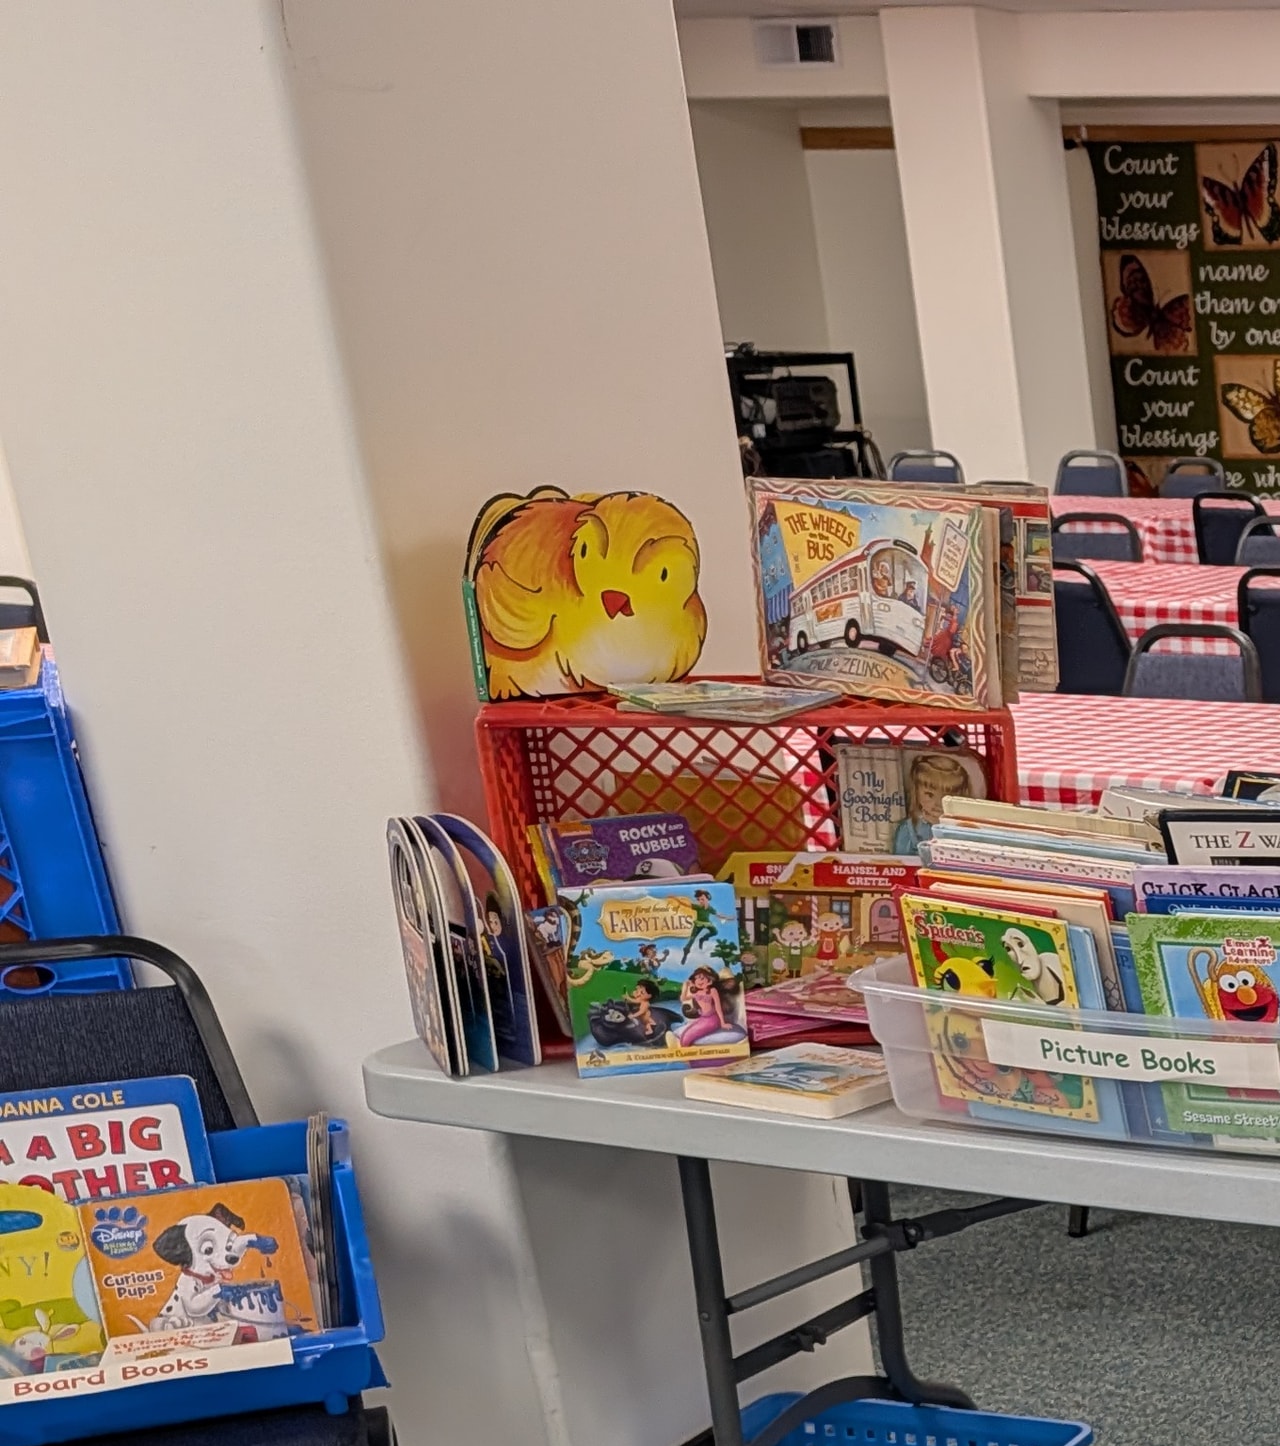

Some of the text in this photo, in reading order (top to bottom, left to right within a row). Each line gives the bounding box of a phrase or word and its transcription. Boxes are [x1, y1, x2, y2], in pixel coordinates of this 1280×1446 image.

[1104, 145, 1179, 175] Count
[1116, 187, 1173, 214] your
[1100, 217, 1199, 249] blessings
[1200, 263, 1269, 281] name
[1195, 293, 1254, 314] them
[1210, 323, 1235, 350] by
[1124, 358, 1199, 387] Count
[1140, 400, 1194, 426] your
[1121, 426, 1218, 455] blessings
[784, 512, 855, 547] THE WHEELS
[807, 540, 834, 562] BUS
[852, 770, 884, 792] My
[843, 788, 905, 808] Goodnight
[853, 806, 892, 823] Book
[619, 823, 667, 842] ROCKY
[1190, 834, 1232, 849] THE
[1235, 830, 1255, 849] Z
[630, 835, 687, 856] RUBBLE
[833, 865, 906, 876] HANSEL AND
[847, 876, 892, 887] GRETEL
[1141, 881, 1214, 898] CLICK,
[634, 905, 651, 916] first
[609, 911, 693, 933] FAIRYTALES
[913, 915, 985, 944] Spider's
[1222, 947, 1276, 960] Learning
[1040, 1038, 1216, 1075] Picture Books
[71, 1090, 126, 1109] COLE
[1183, 1110, 1231, 1126] Sesame
[26, 1116, 162, 1161] A BIG
[94, 1227, 143, 1243] Disney
[103, 1270, 164, 1288] Curious
[117, 1284, 156, 1298] Pups
[14, 1355, 209, 1396] Board Books
